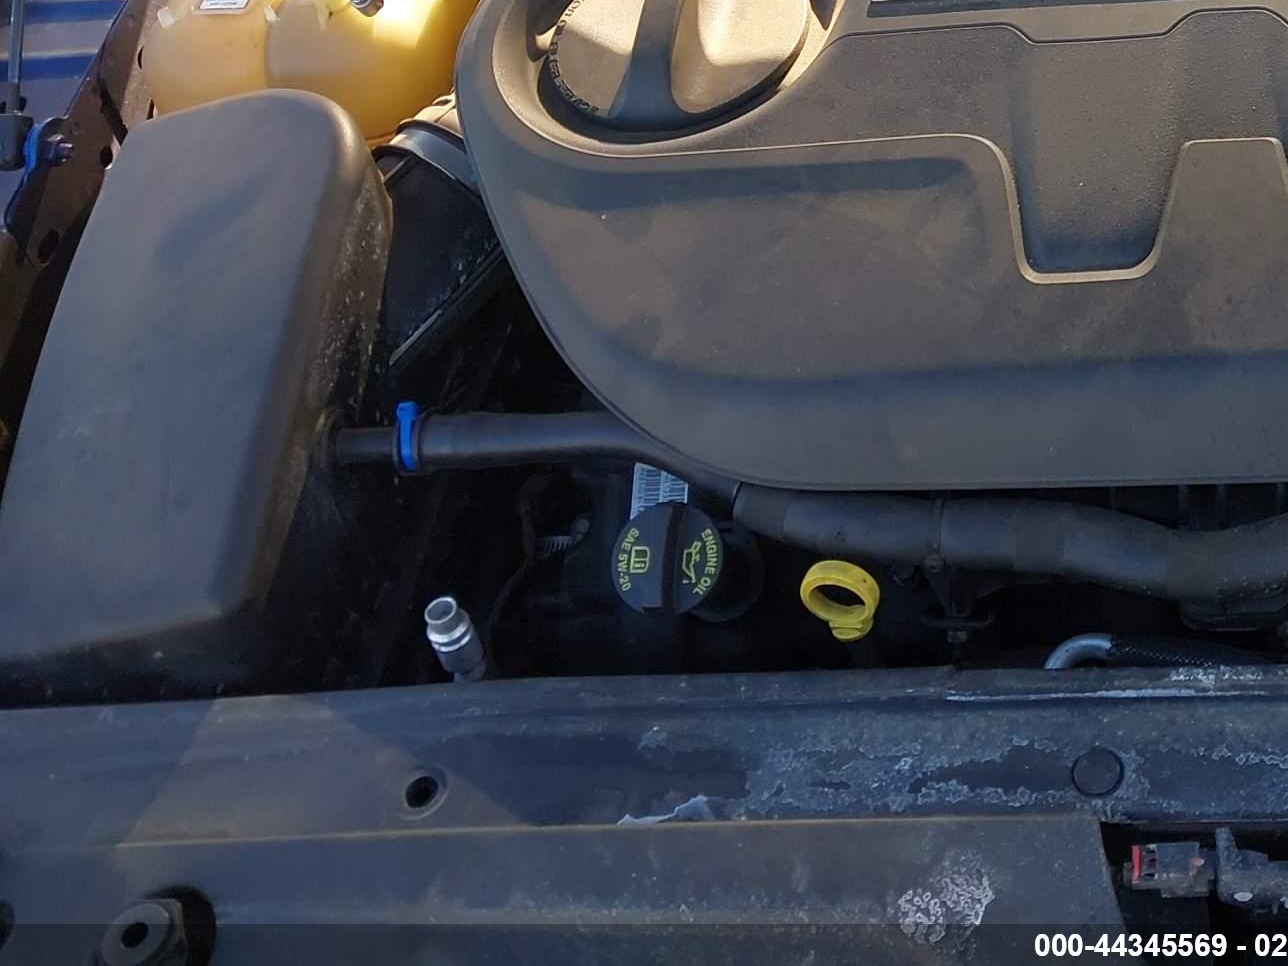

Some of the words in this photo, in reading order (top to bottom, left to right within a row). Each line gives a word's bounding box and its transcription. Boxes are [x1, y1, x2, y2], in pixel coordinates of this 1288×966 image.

[621, 528, 639, 551] SAE
[701, 529, 717, 575] ENGINE
[617, 554, 631, 591] 5W-20
[692, 577, 711, 595] OIL
